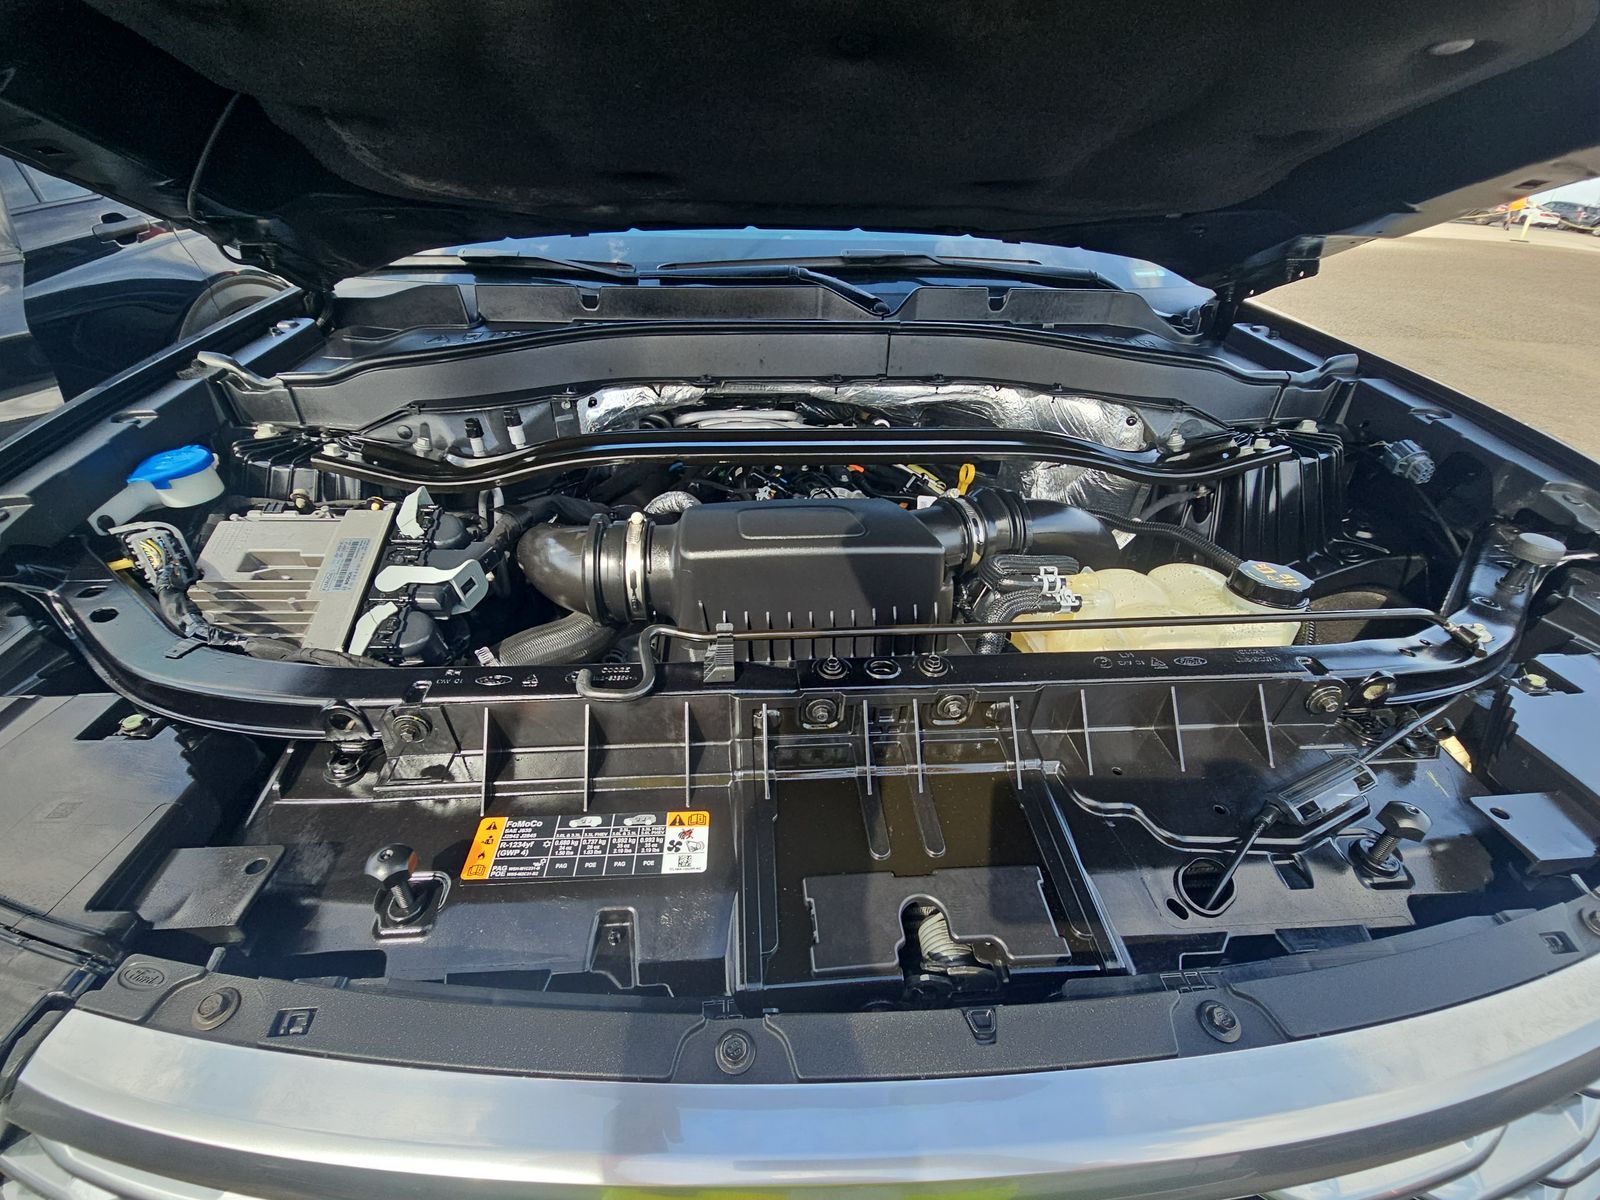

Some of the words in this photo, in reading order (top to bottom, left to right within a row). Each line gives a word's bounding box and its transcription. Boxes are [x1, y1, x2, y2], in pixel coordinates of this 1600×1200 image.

[506, 820, 543, 828] FoMoCo
[500, 841, 535, 849] R-1234yf
[497, 849, 519, 857] (GWP
[520, 849, 529, 857] 4)
